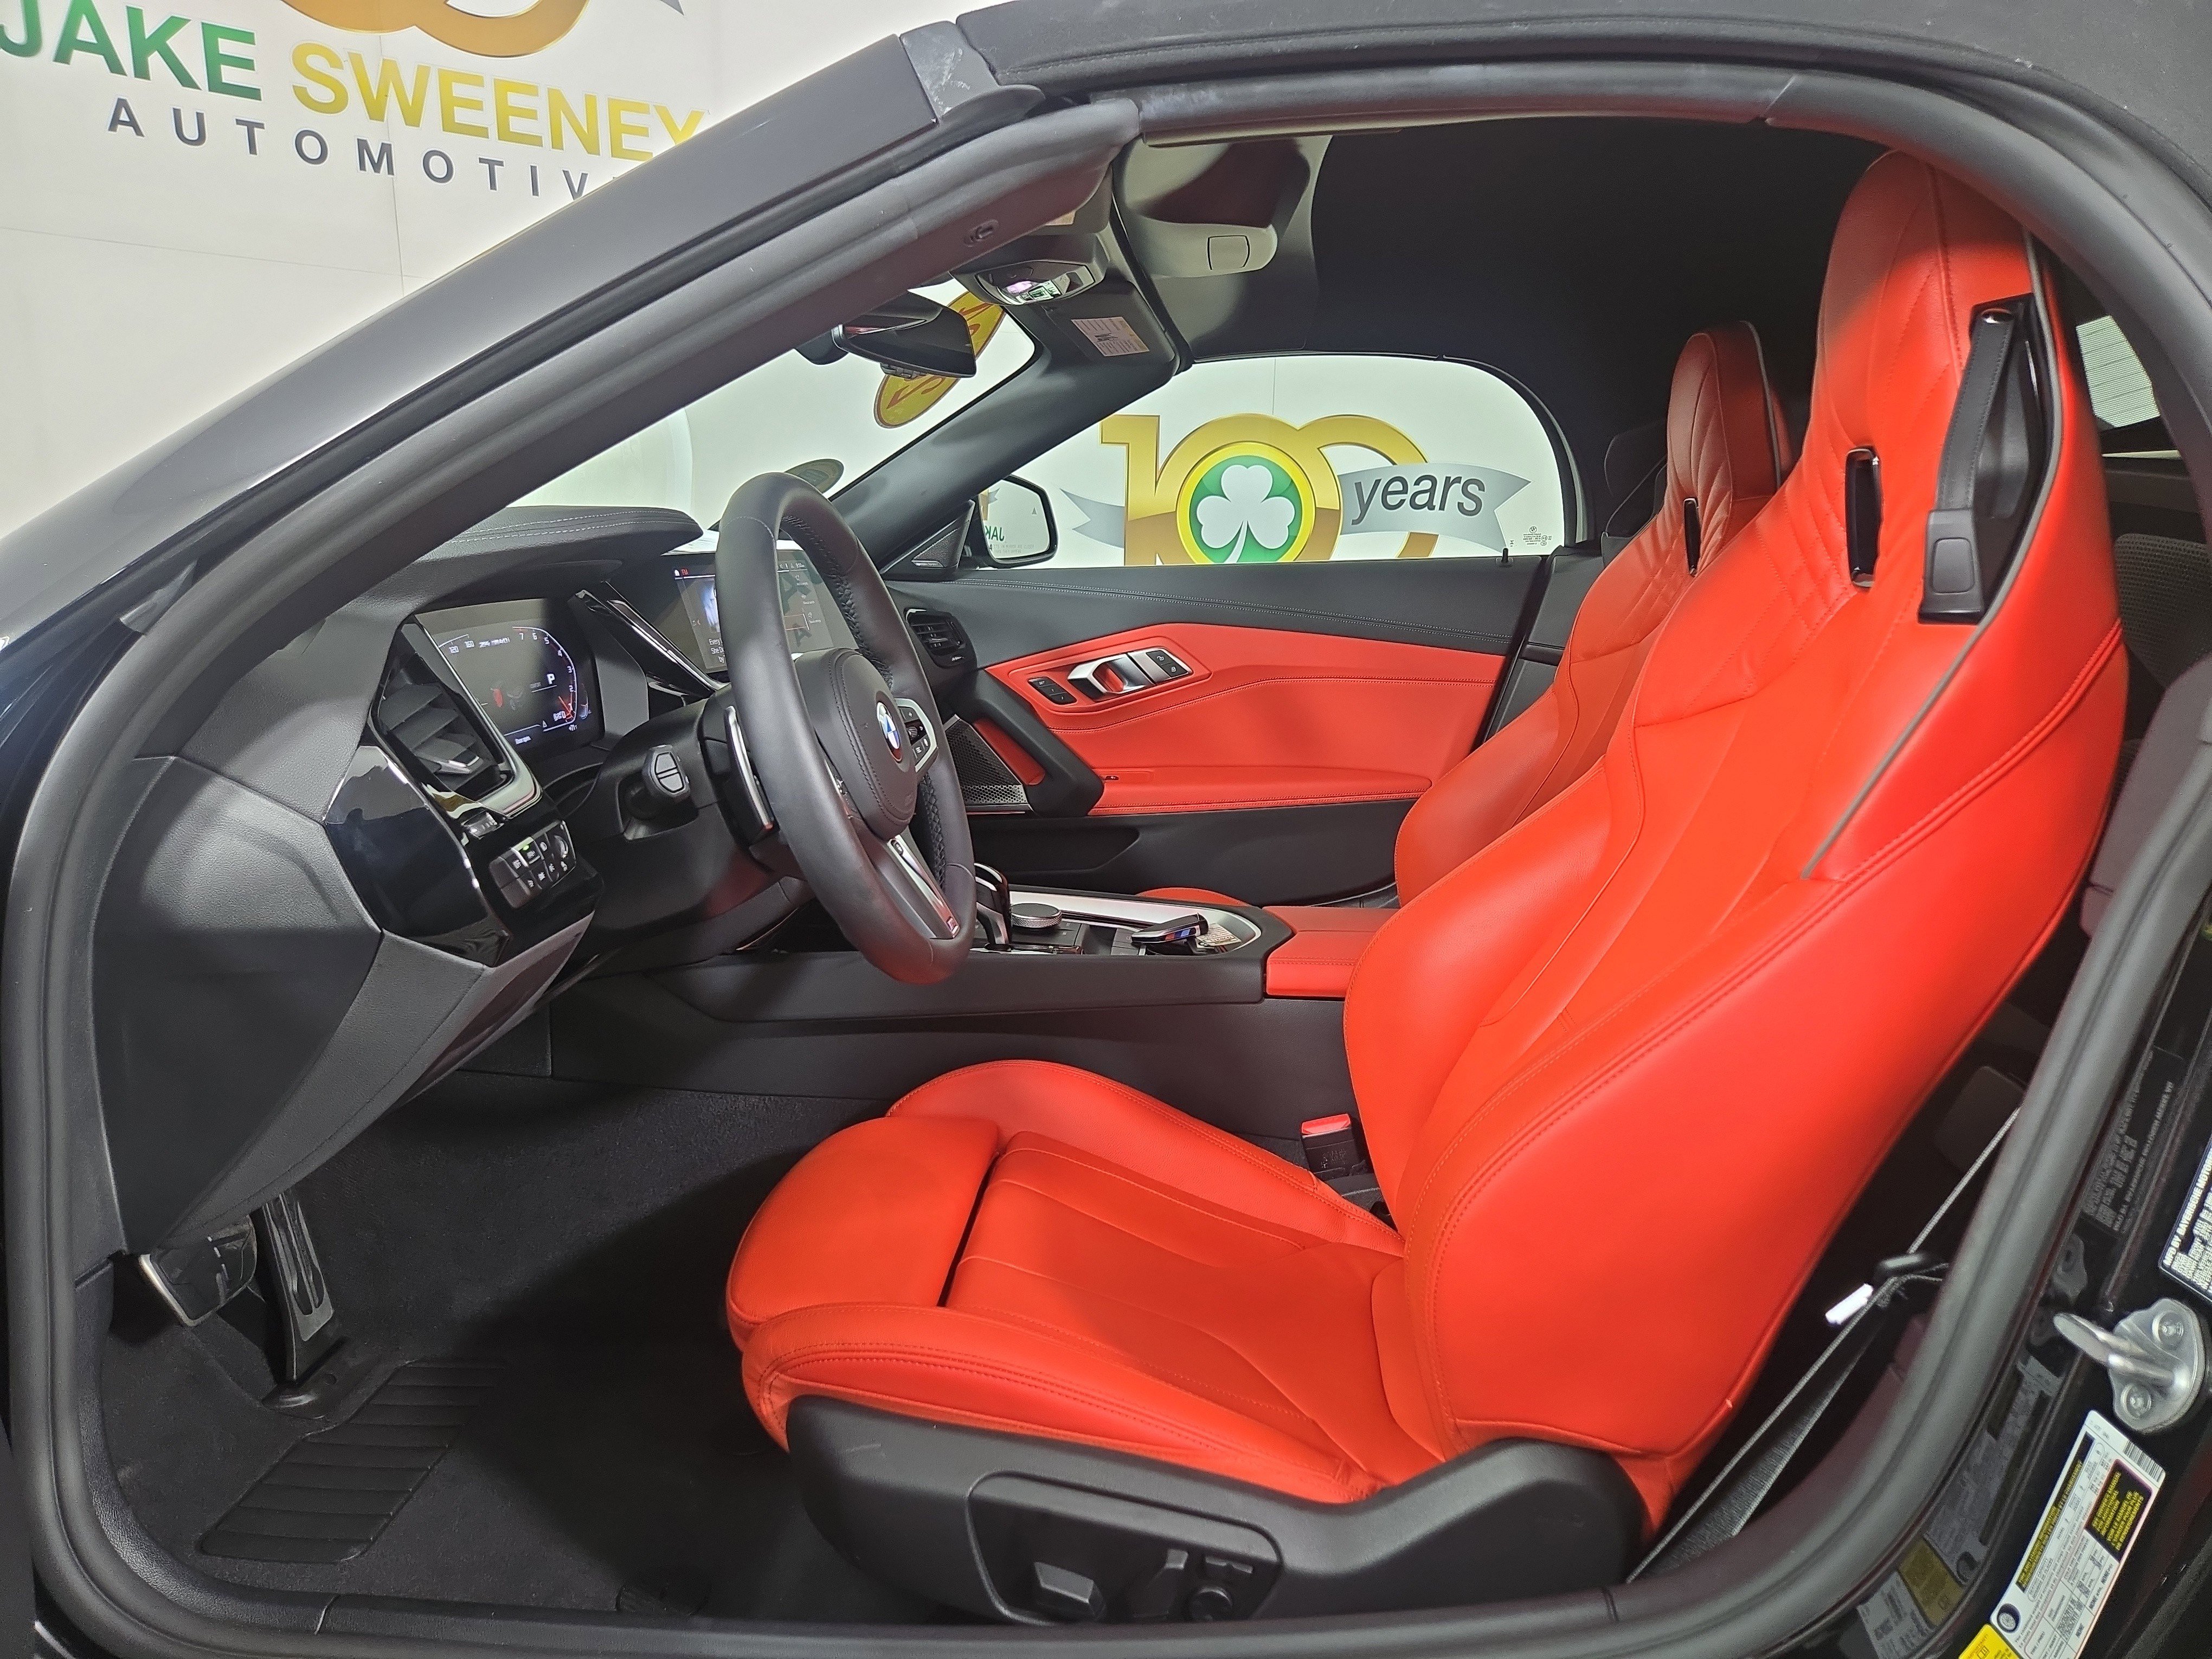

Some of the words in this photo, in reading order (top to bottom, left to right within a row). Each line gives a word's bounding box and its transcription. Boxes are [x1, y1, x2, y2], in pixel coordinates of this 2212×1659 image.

[0, 0, 262, 102] JAKE
[108, 98, 621, 201] AUTOMOTIV
[1351, 473, 1486, 526] years
[519, 632, 524, 640] 7
[532, 632, 538, 641] 6
[544, 637, 550, 645] 5
[546, 673, 555, 685] P
[2163, 1246, 2176, 1265] MFD
[2171, 1235, 2181, 1248] BY
[2177, 1186, 2202, 1236] BAYERISCHE
